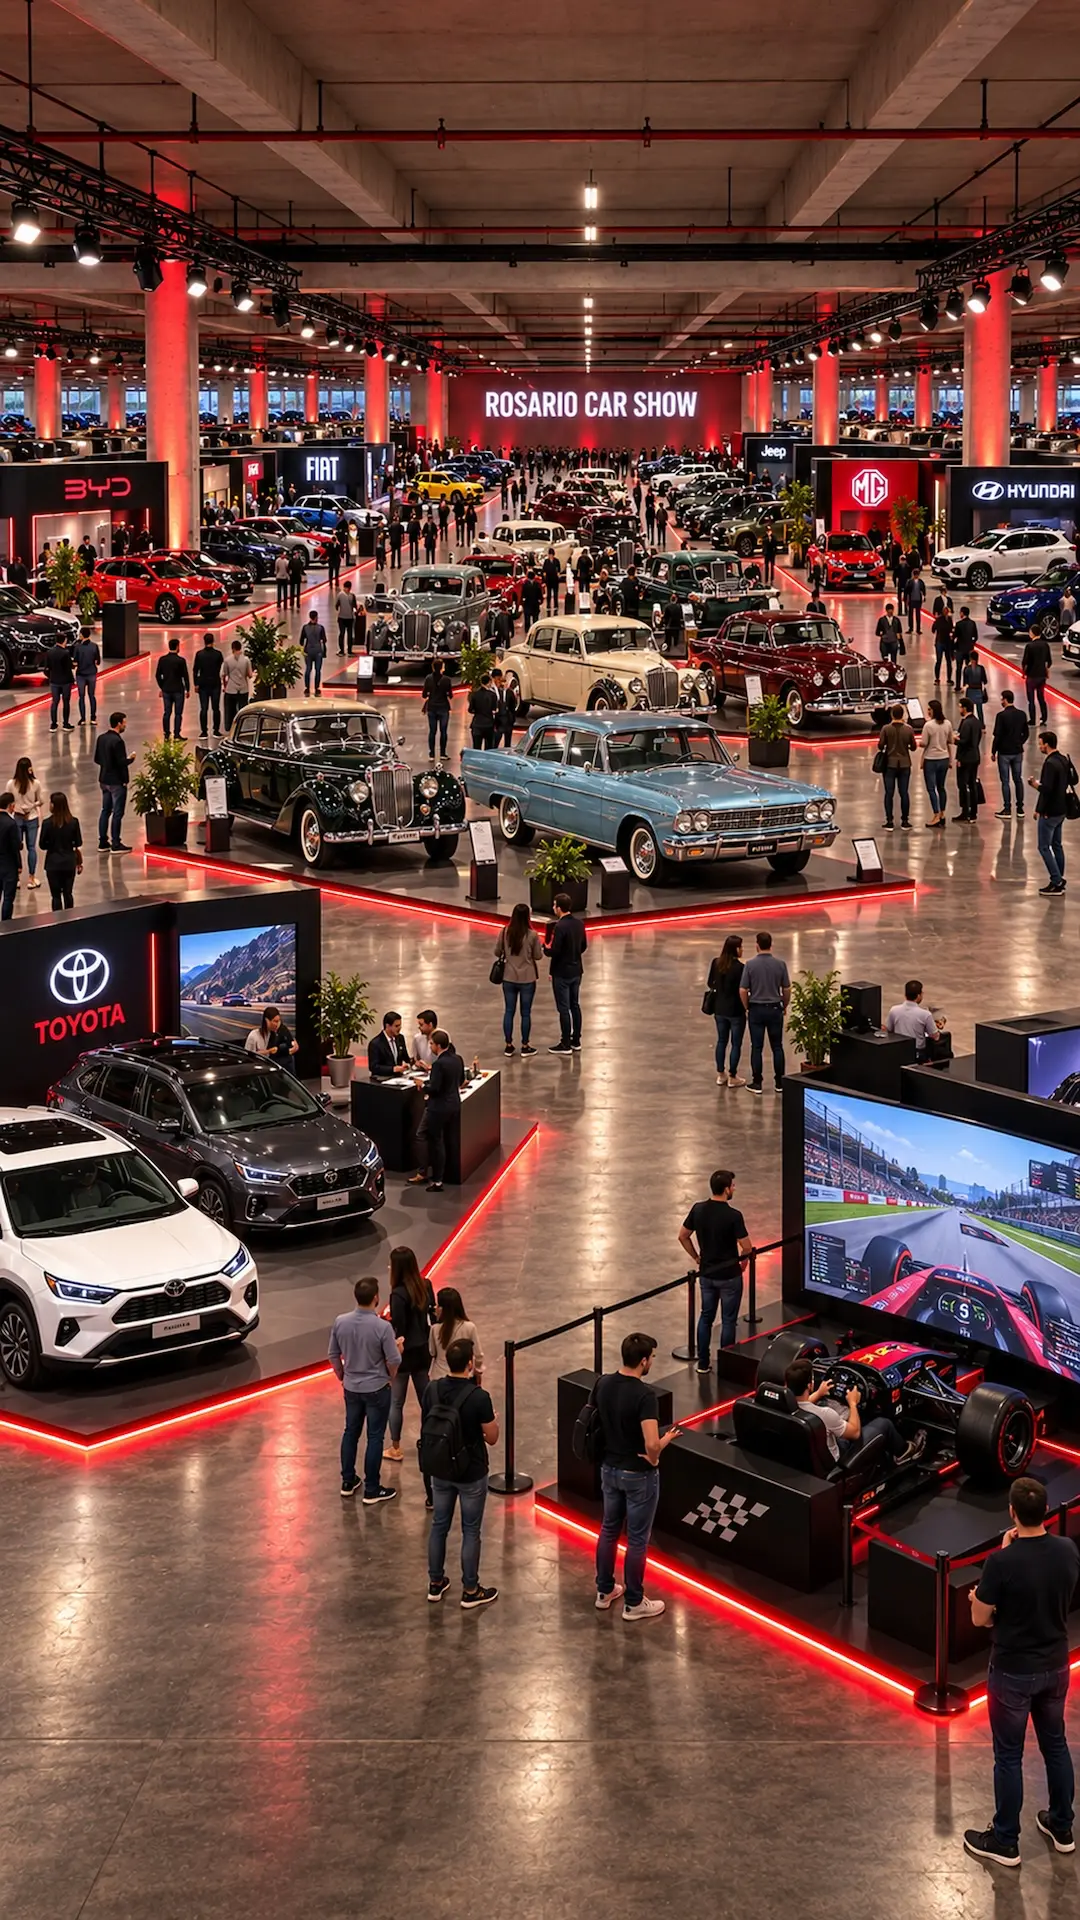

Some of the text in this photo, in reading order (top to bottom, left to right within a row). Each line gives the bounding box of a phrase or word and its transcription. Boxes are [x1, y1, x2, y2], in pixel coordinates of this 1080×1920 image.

[485, 391, 698, 418] ROSARIO CAR SHOW
[761, 444, 787, 460] Jeep
[306, 456, 340, 481] FIAT
[64, 477, 131, 500] BYD
[854, 472, 886, 504] MG
[1007, 484, 1075, 499] HYUNDAI
[34, 1003, 126, 1045] TOYOTA
